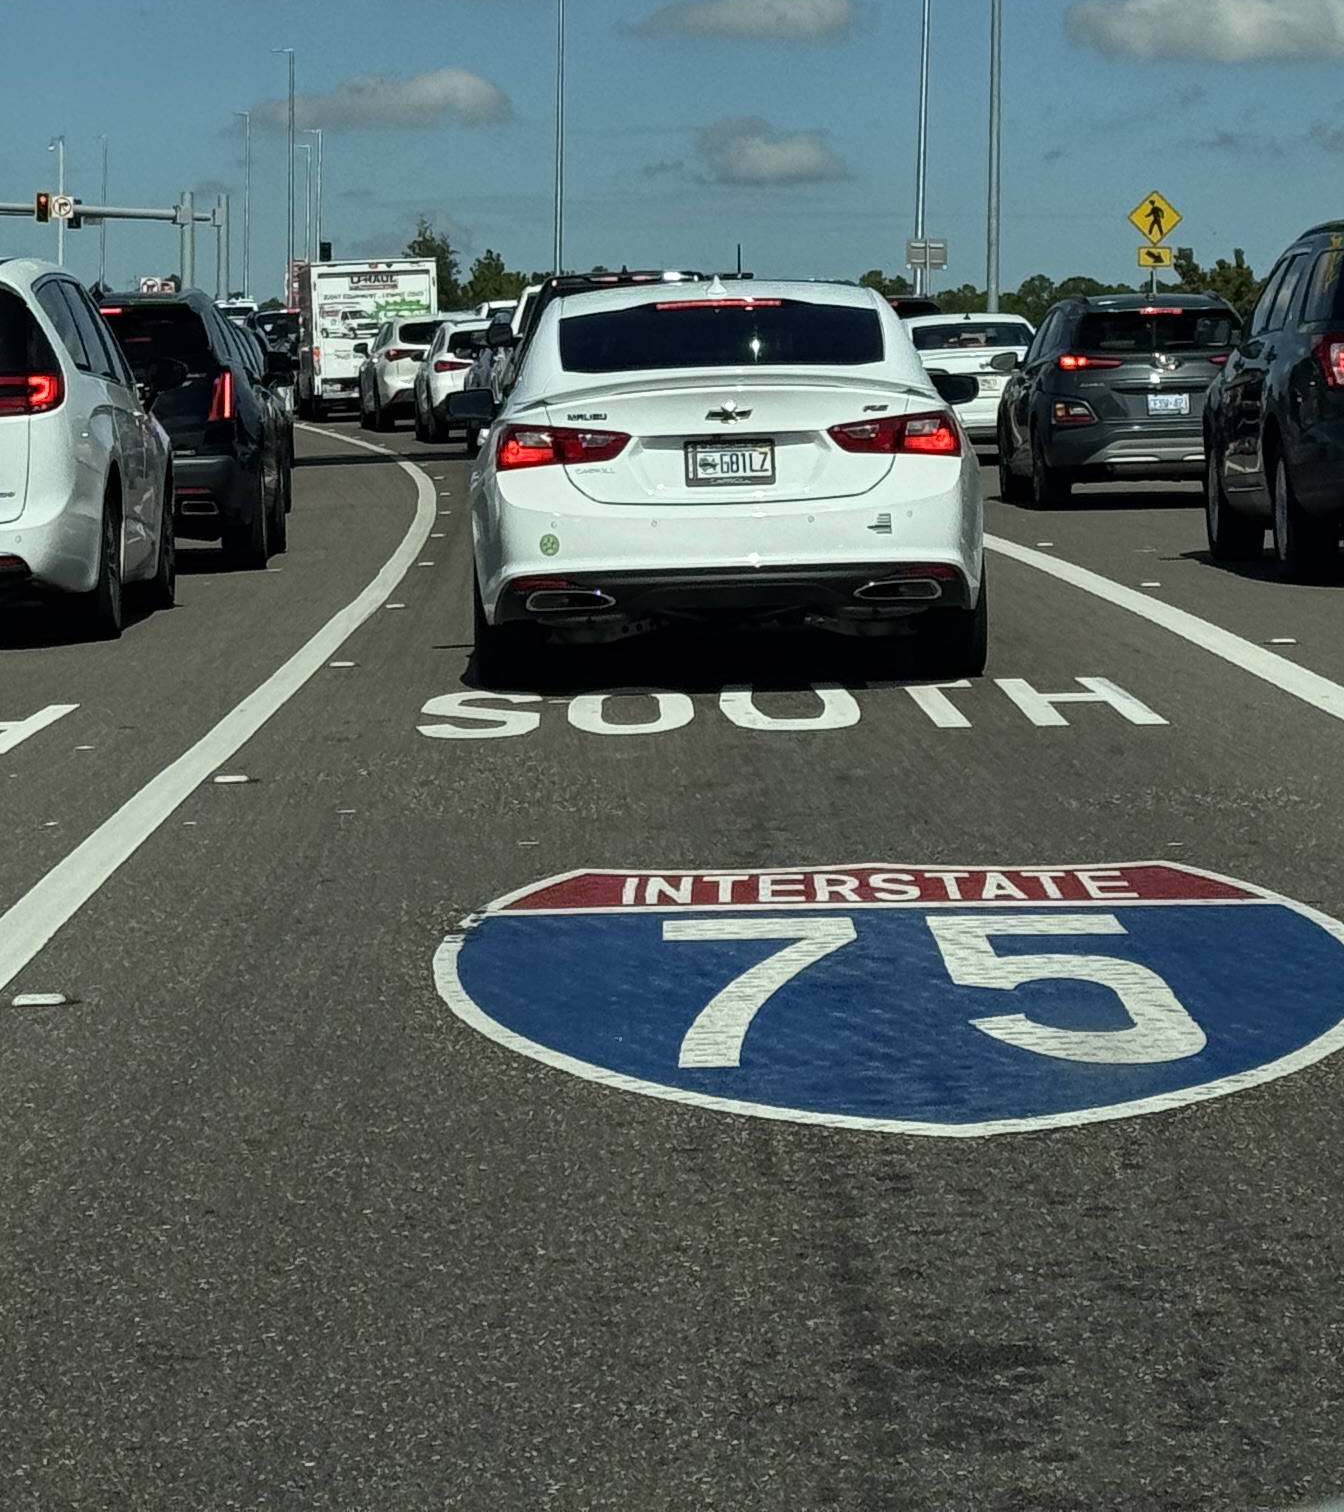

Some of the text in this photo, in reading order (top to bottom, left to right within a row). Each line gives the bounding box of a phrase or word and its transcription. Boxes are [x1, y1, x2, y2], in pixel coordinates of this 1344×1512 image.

[418, 676, 1169, 740] SOUTH
[620, 869, 1140, 907] INTERSTATE
[662, 913, 1207, 1069] 75
